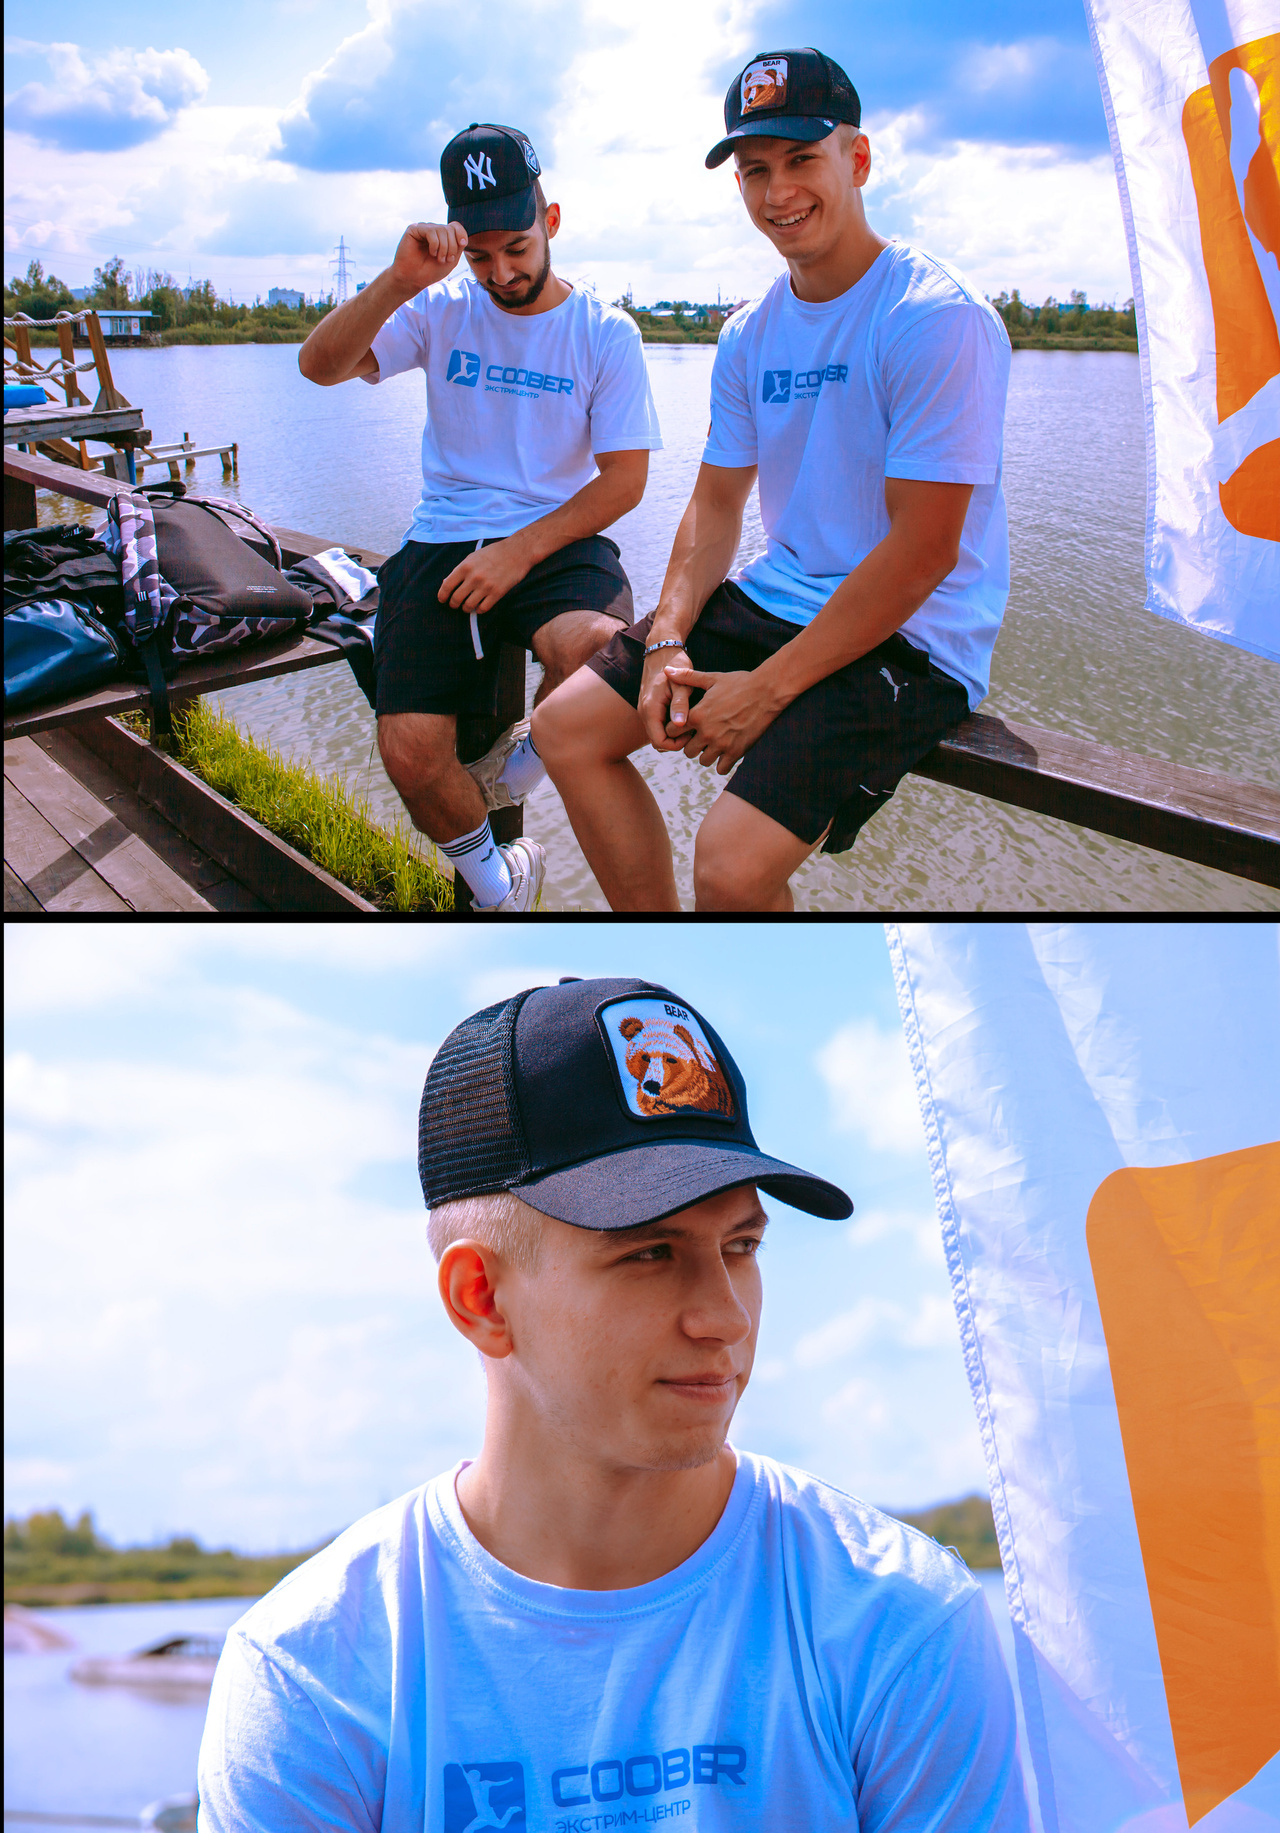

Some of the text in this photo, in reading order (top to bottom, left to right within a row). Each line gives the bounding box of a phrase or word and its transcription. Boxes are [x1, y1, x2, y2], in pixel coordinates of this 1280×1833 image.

[463, 151, 497, 190] NY
[664, 1003, 690, 1021] BEAR
[550, 1744, 748, 1808] COOBER
[554, 1799, 692, 1833] ЭКСТРИМ-ЦЕНТР
